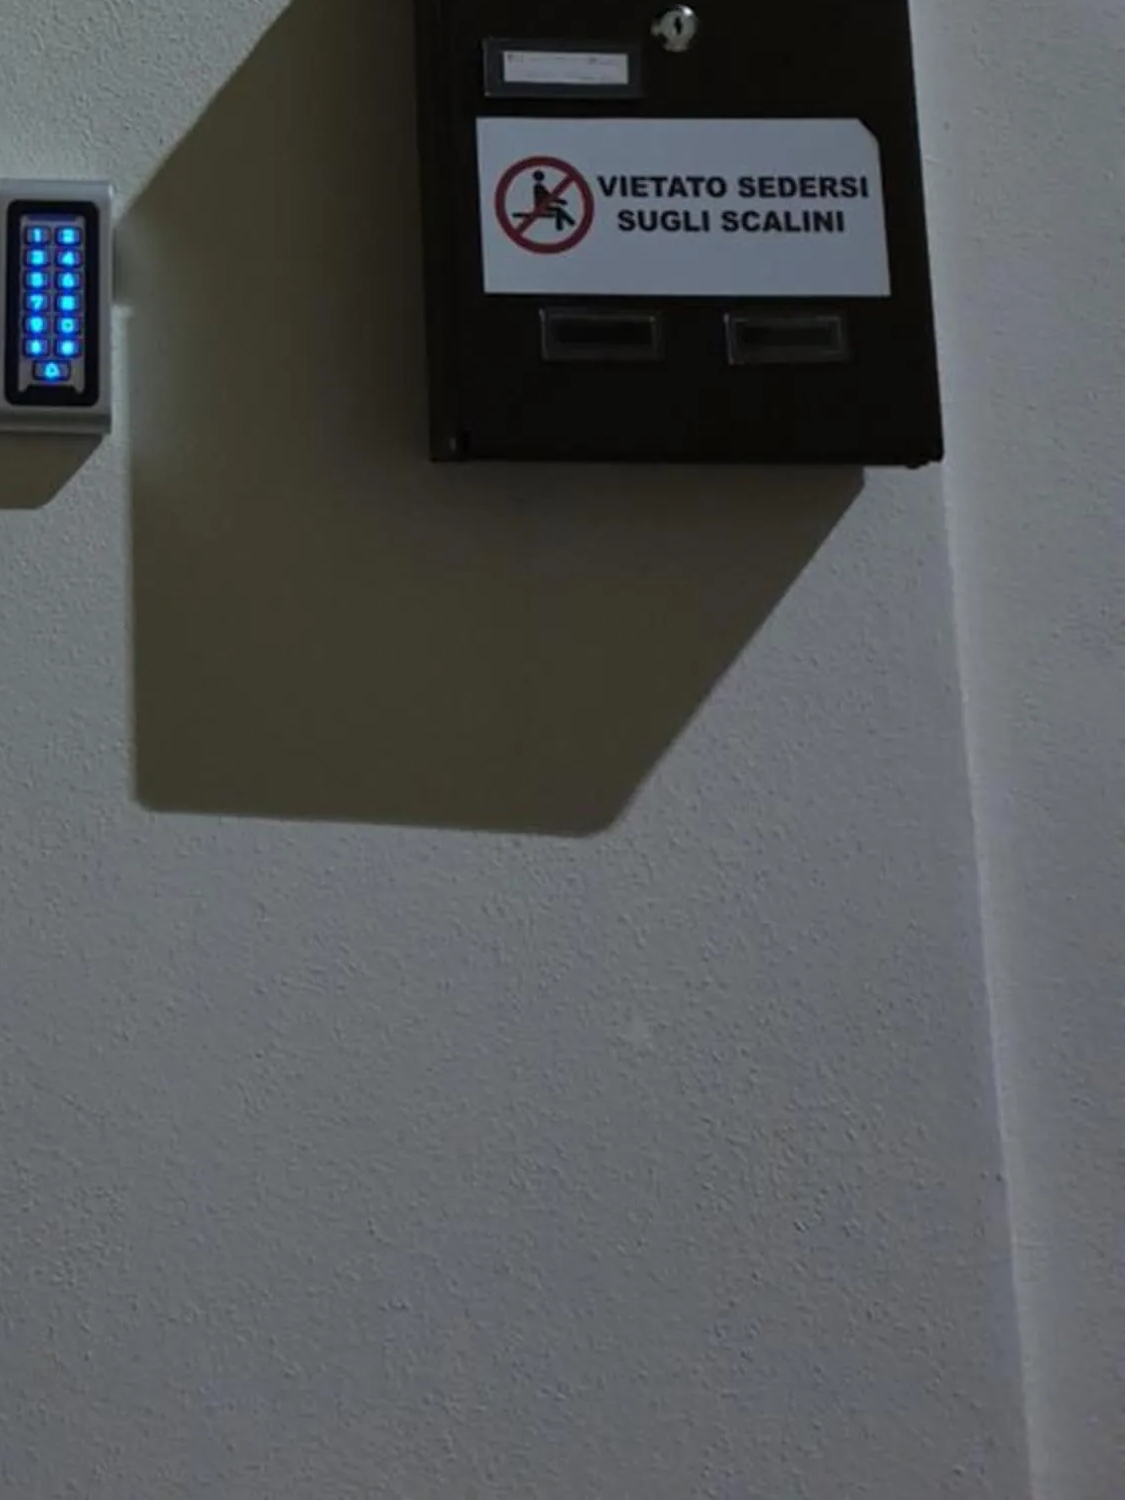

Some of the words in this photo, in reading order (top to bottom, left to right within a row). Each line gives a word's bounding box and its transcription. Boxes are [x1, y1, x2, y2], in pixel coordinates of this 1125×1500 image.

[597, 175, 728, 199] VIETATO
[737, 175, 870, 199] SEDERSI
[616, 209, 710, 233] SUGLI
[720, 209, 846, 233] SCALINI
